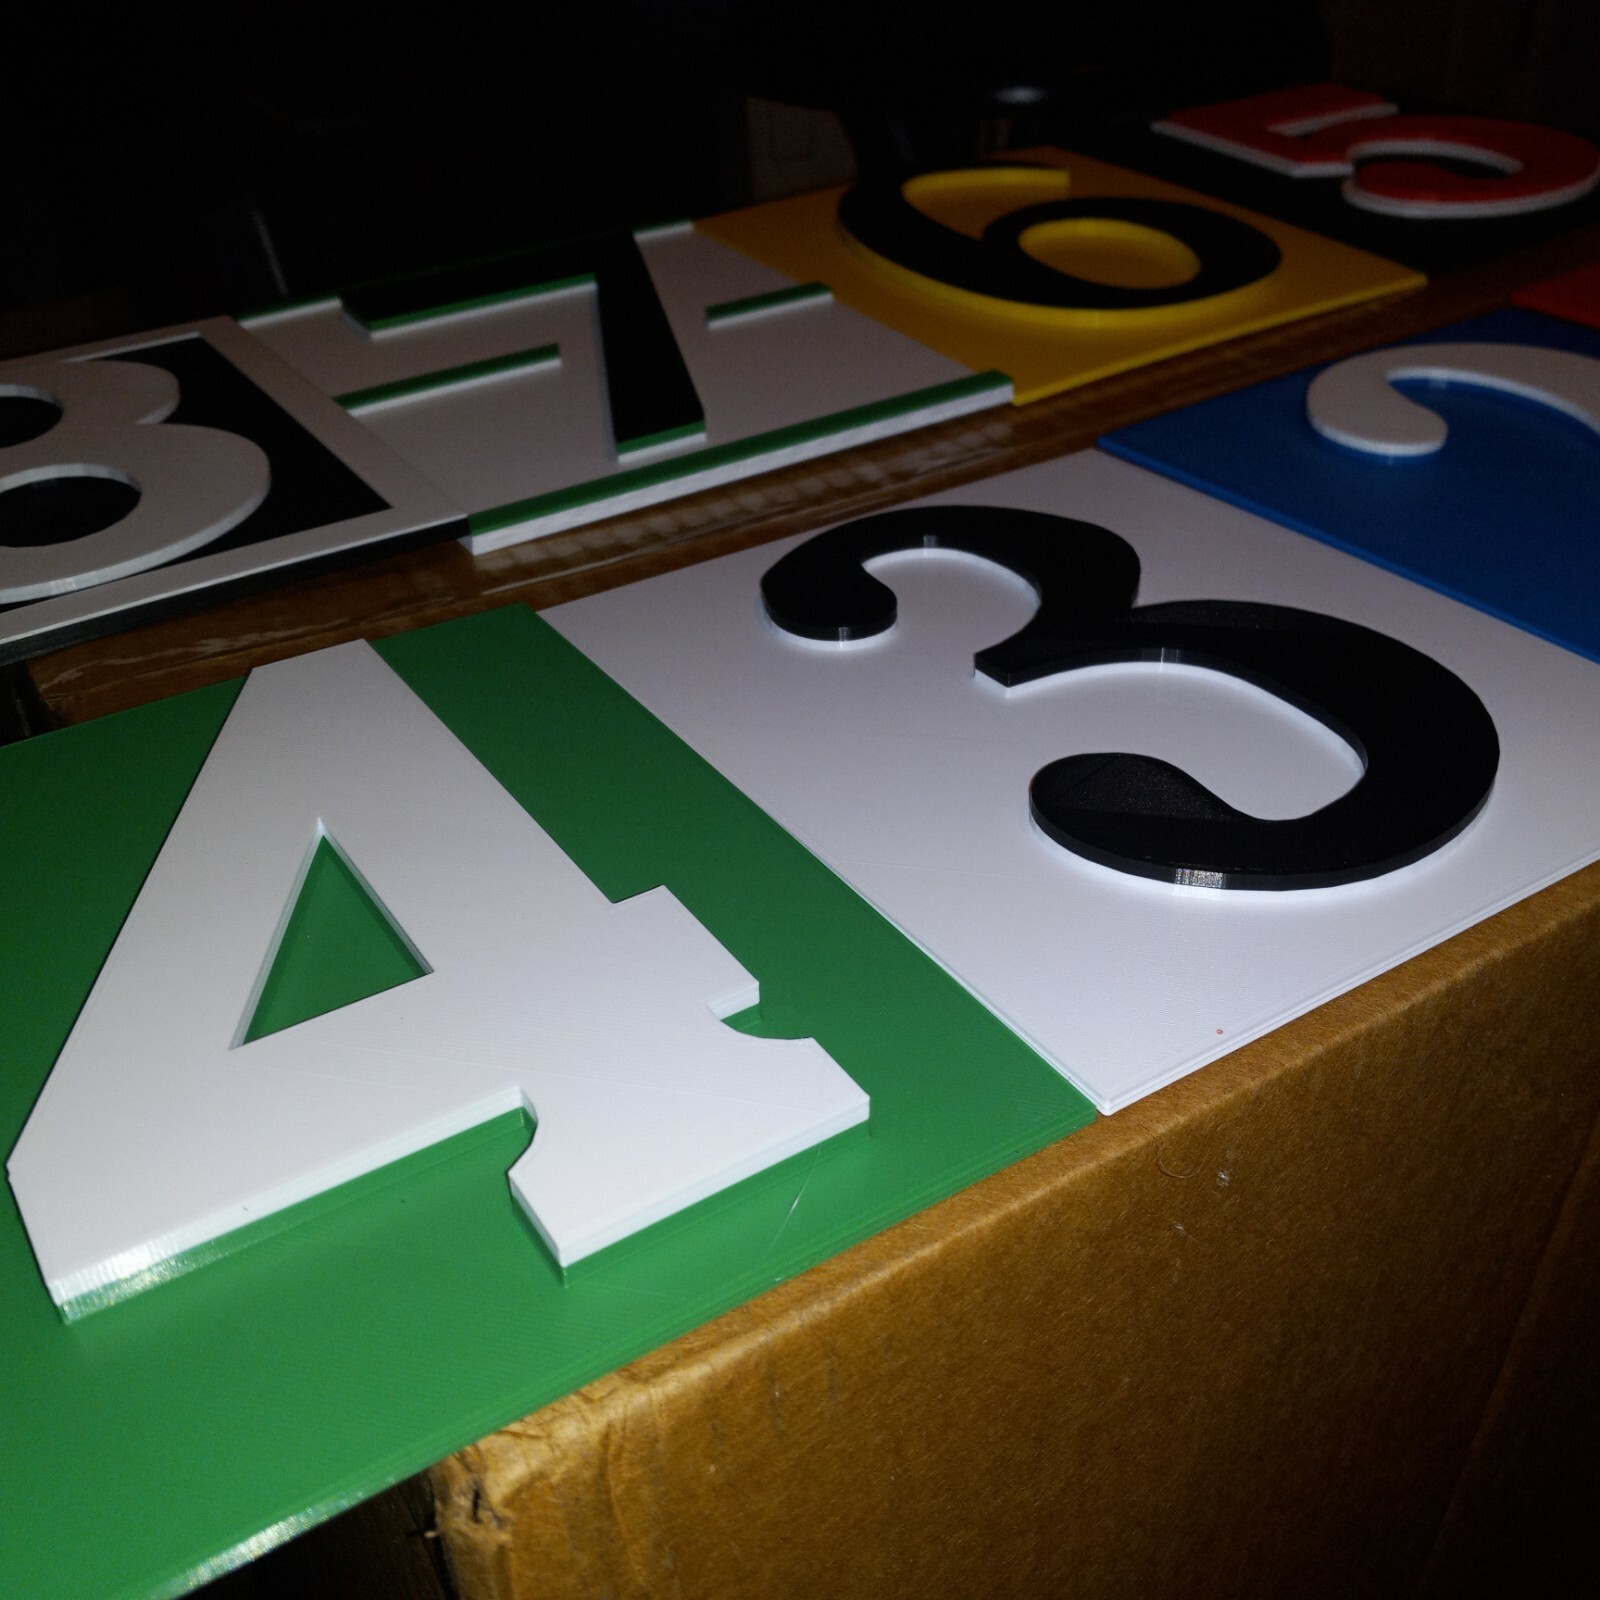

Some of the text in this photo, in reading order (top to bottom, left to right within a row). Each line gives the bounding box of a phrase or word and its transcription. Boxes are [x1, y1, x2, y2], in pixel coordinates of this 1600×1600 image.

[838, 164, 1281, 311] 6
[1150, 82, 1600, 219] 5
[338, 230, 706, 462] 7
[760, 505, 1500, 891] 3
[6, 638, 870, 1320] 4
